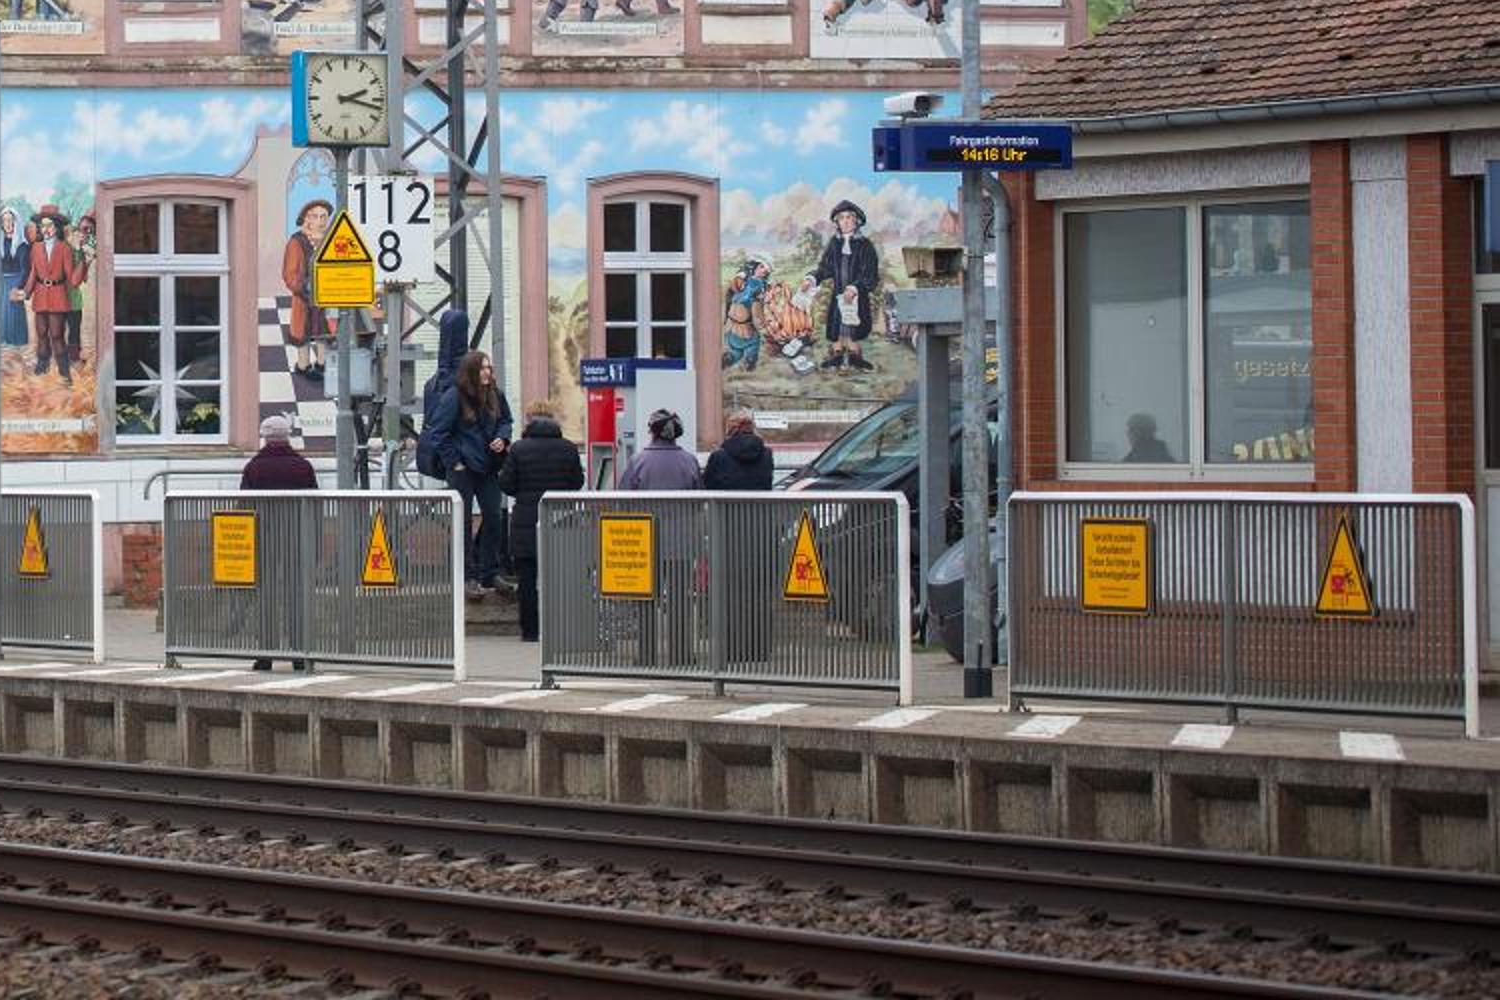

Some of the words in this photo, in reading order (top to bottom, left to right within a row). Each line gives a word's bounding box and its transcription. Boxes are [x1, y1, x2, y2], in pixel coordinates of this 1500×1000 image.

[949, 135, 1040, 148] Fahrgastinformation
[961, 148, 1000, 162] 14:16
[1002, 147, 1028, 162] Uhr
[353, 181, 431, 225] 112
[377, 229, 403, 273] 8
